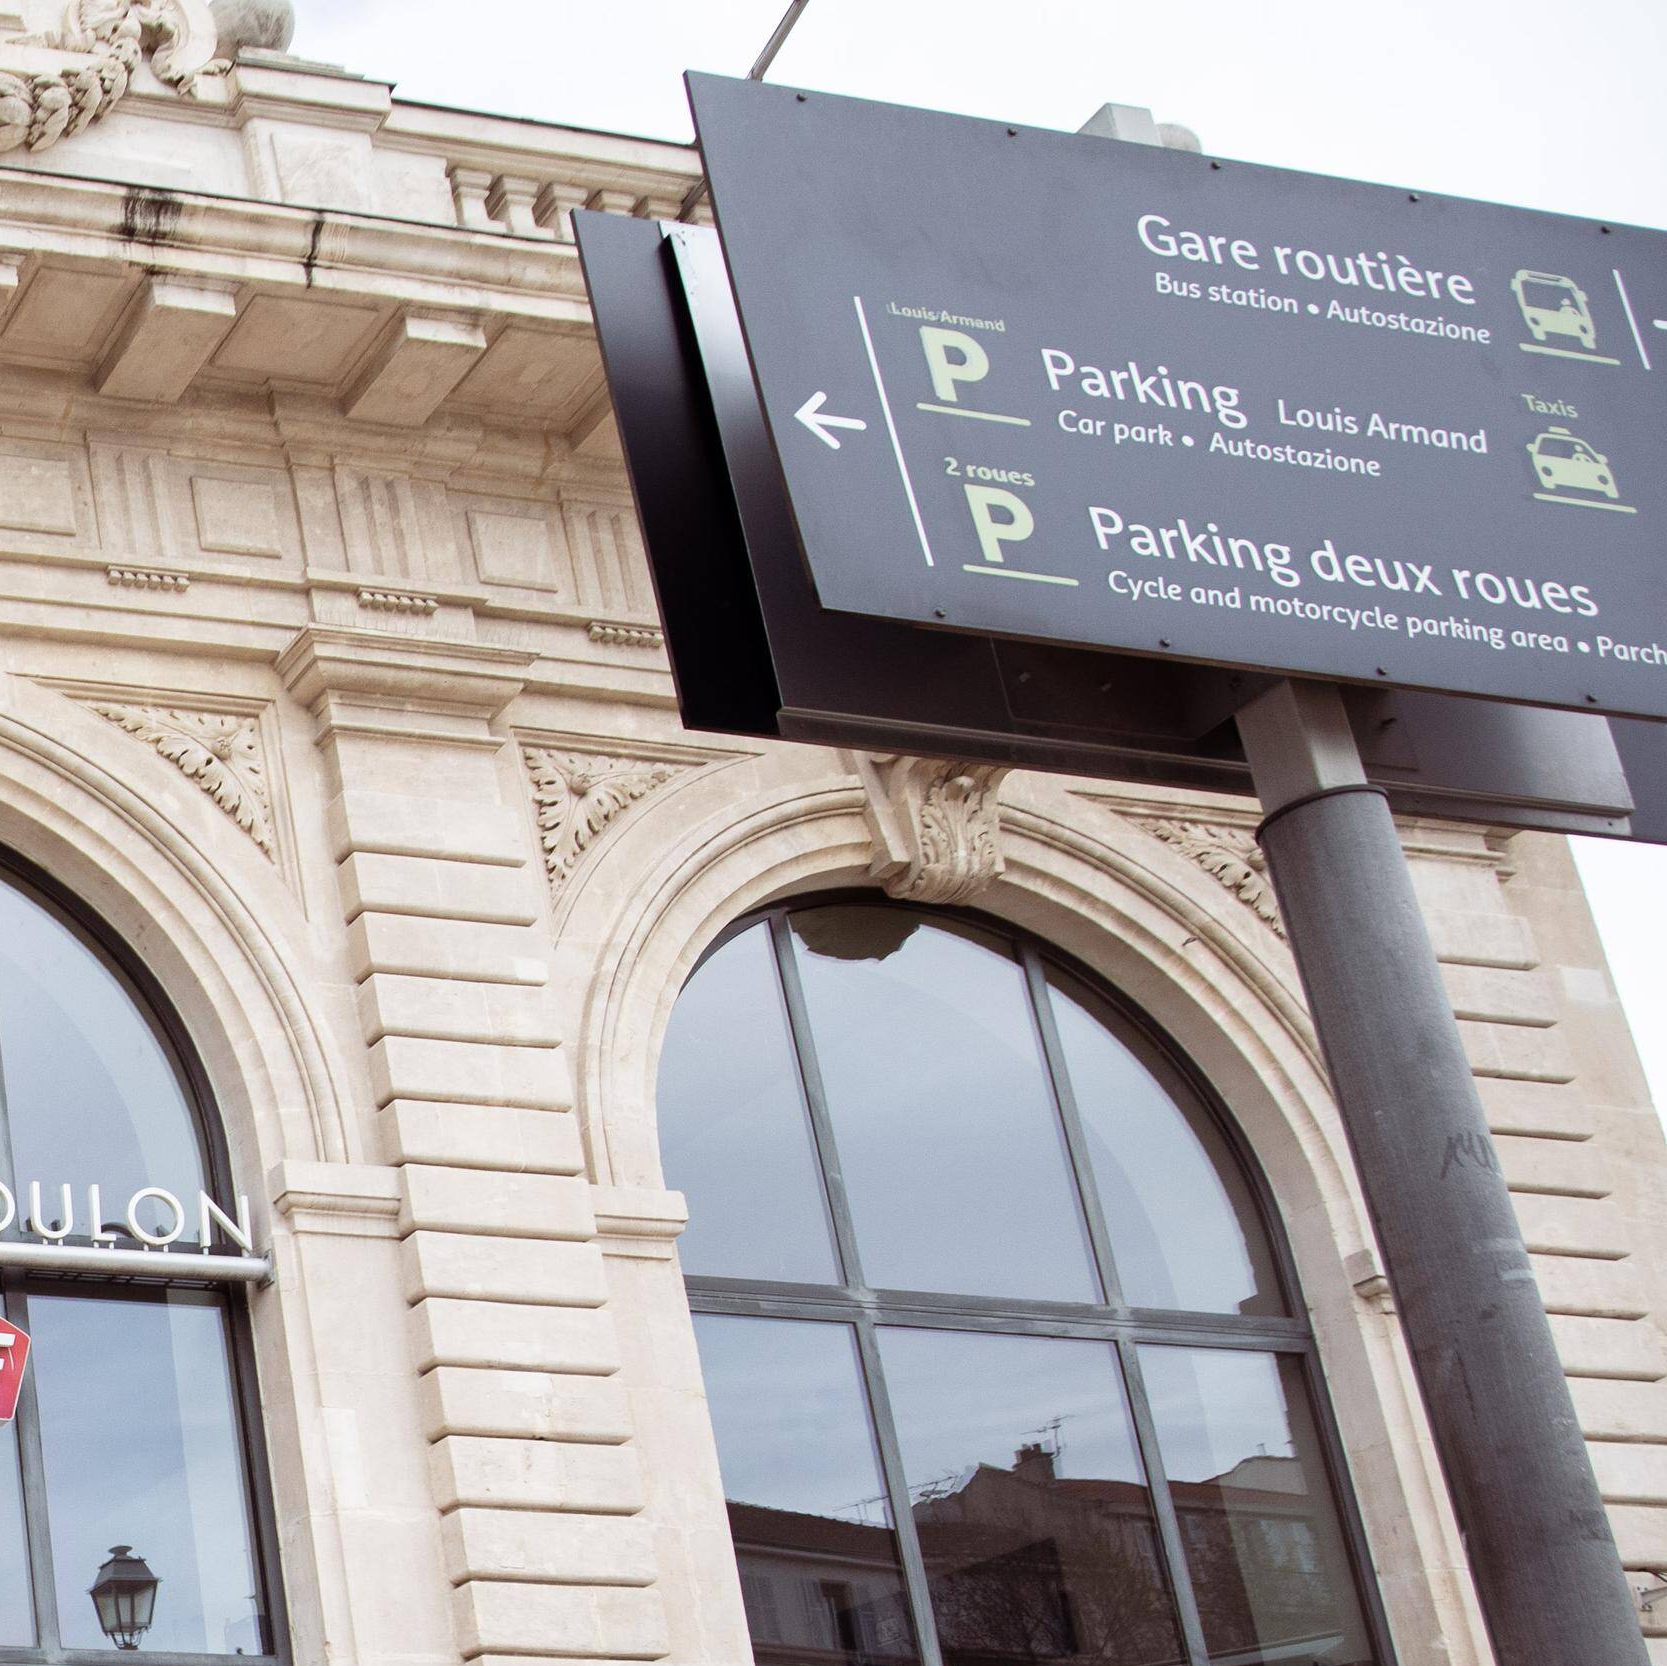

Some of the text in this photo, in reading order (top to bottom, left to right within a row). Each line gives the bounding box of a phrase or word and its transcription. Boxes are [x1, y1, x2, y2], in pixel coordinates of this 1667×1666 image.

[1137, 214, 1476, 305] Gare routière
[889, 301, 1006, 333] Louis Armand
[1155, 272, 1491, 344] Bus station Autostazione
[919, 325, 990, 402] P
[1041, 348, 1488, 455] Parking Louis Armand
[1058, 409, 1381, 477] Car park Autostazione
[1521, 393, 1579, 418] Taxis
[944, 456, 1035, 488] 2 roues
[964, 484, 1034, 563] P
[1088, 506, 1599, 617] Parking deux roues
[1108, 570, 1182, 602] Cycle
[1190, 586, 1241, 610] and
[1249, 594, 1399, 631] motorcycle
[1405, 616, 1507, 650] parking
[1510, 630, 1570, 654] area
